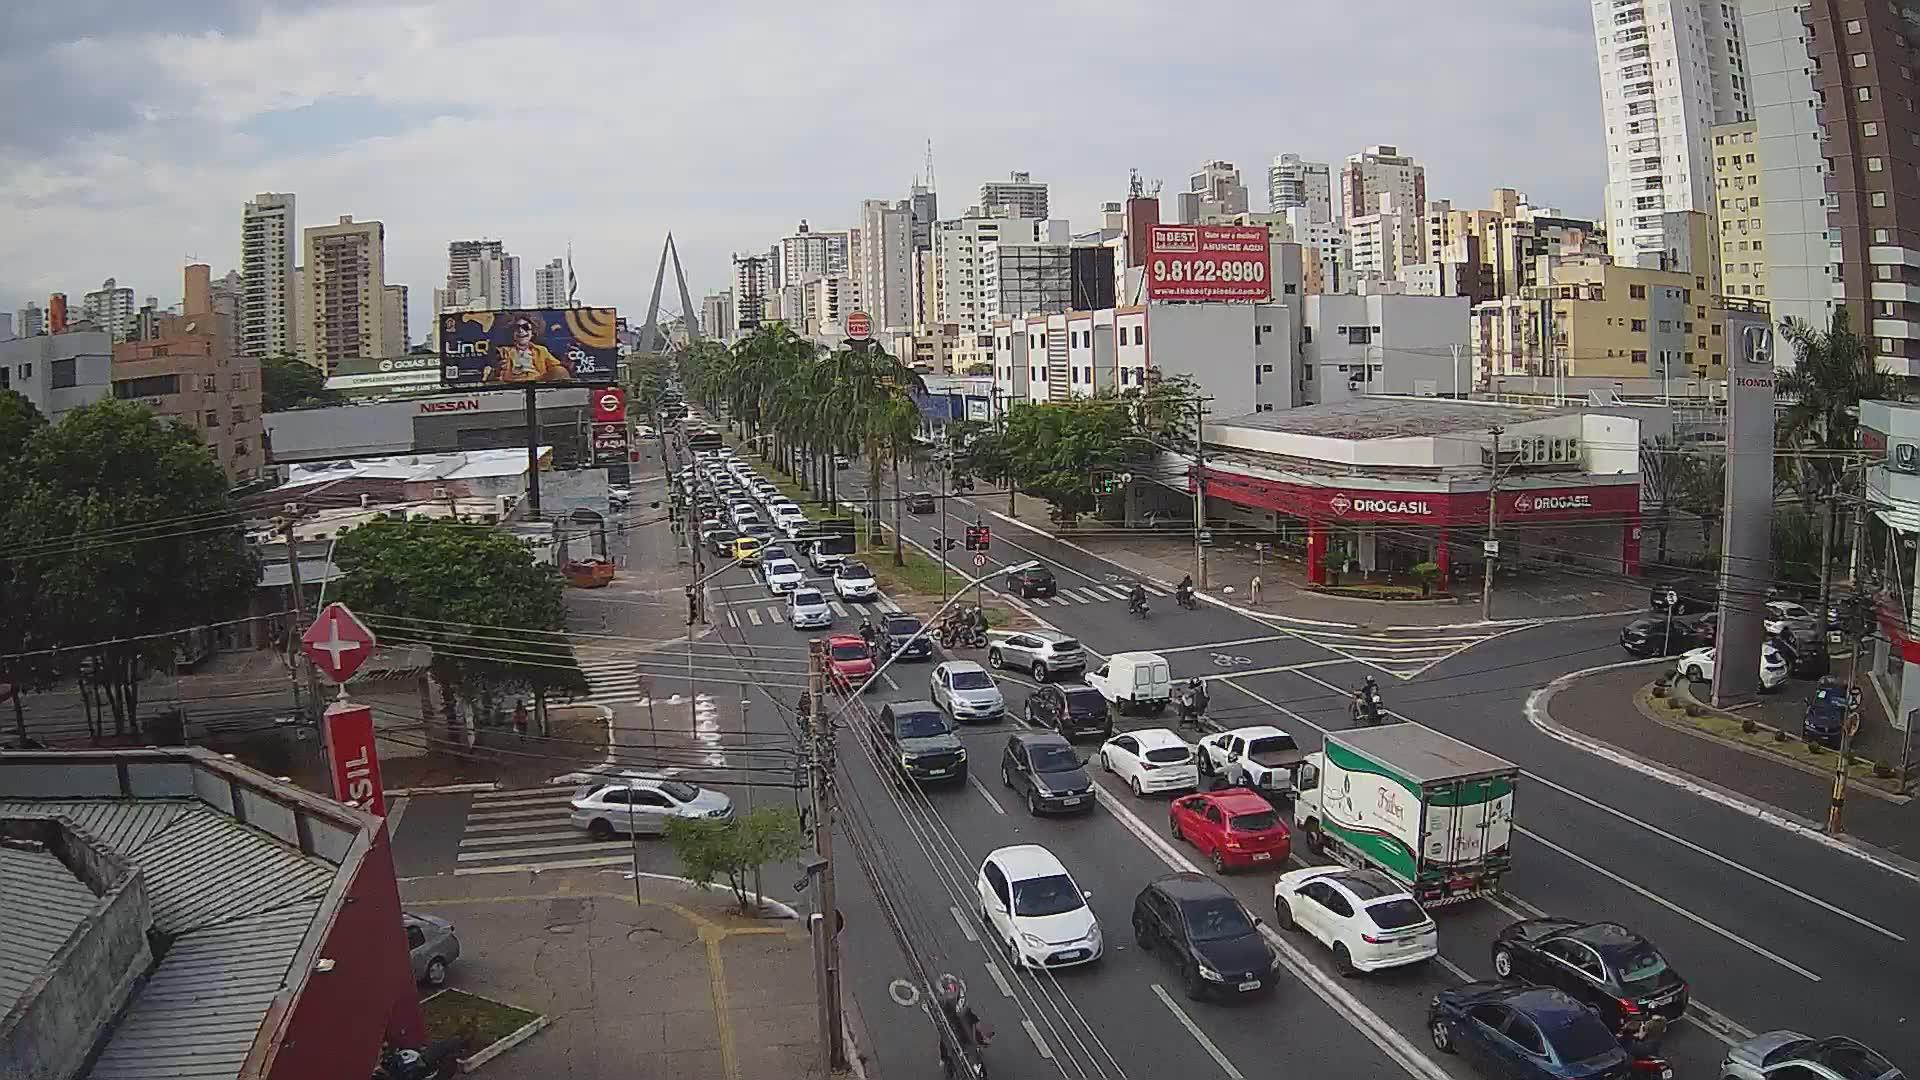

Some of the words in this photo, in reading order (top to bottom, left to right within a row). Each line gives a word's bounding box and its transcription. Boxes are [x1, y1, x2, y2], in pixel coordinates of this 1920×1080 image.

[1167, 231, 1194, 242] BEST
[1203, 243, 1242, 251] ANUNCIE
[1243, 244, 1264, 252] AQUI
[1154, 260, 1265, 282] 9.8122-8980
[1736, 377, 1773, 388] HONDA
[420, 399, 479, 413] NISSAN
[1353, 499, 1432, 515] DROGASIL
[1534, 495, 1592, 510] DROGASIL
